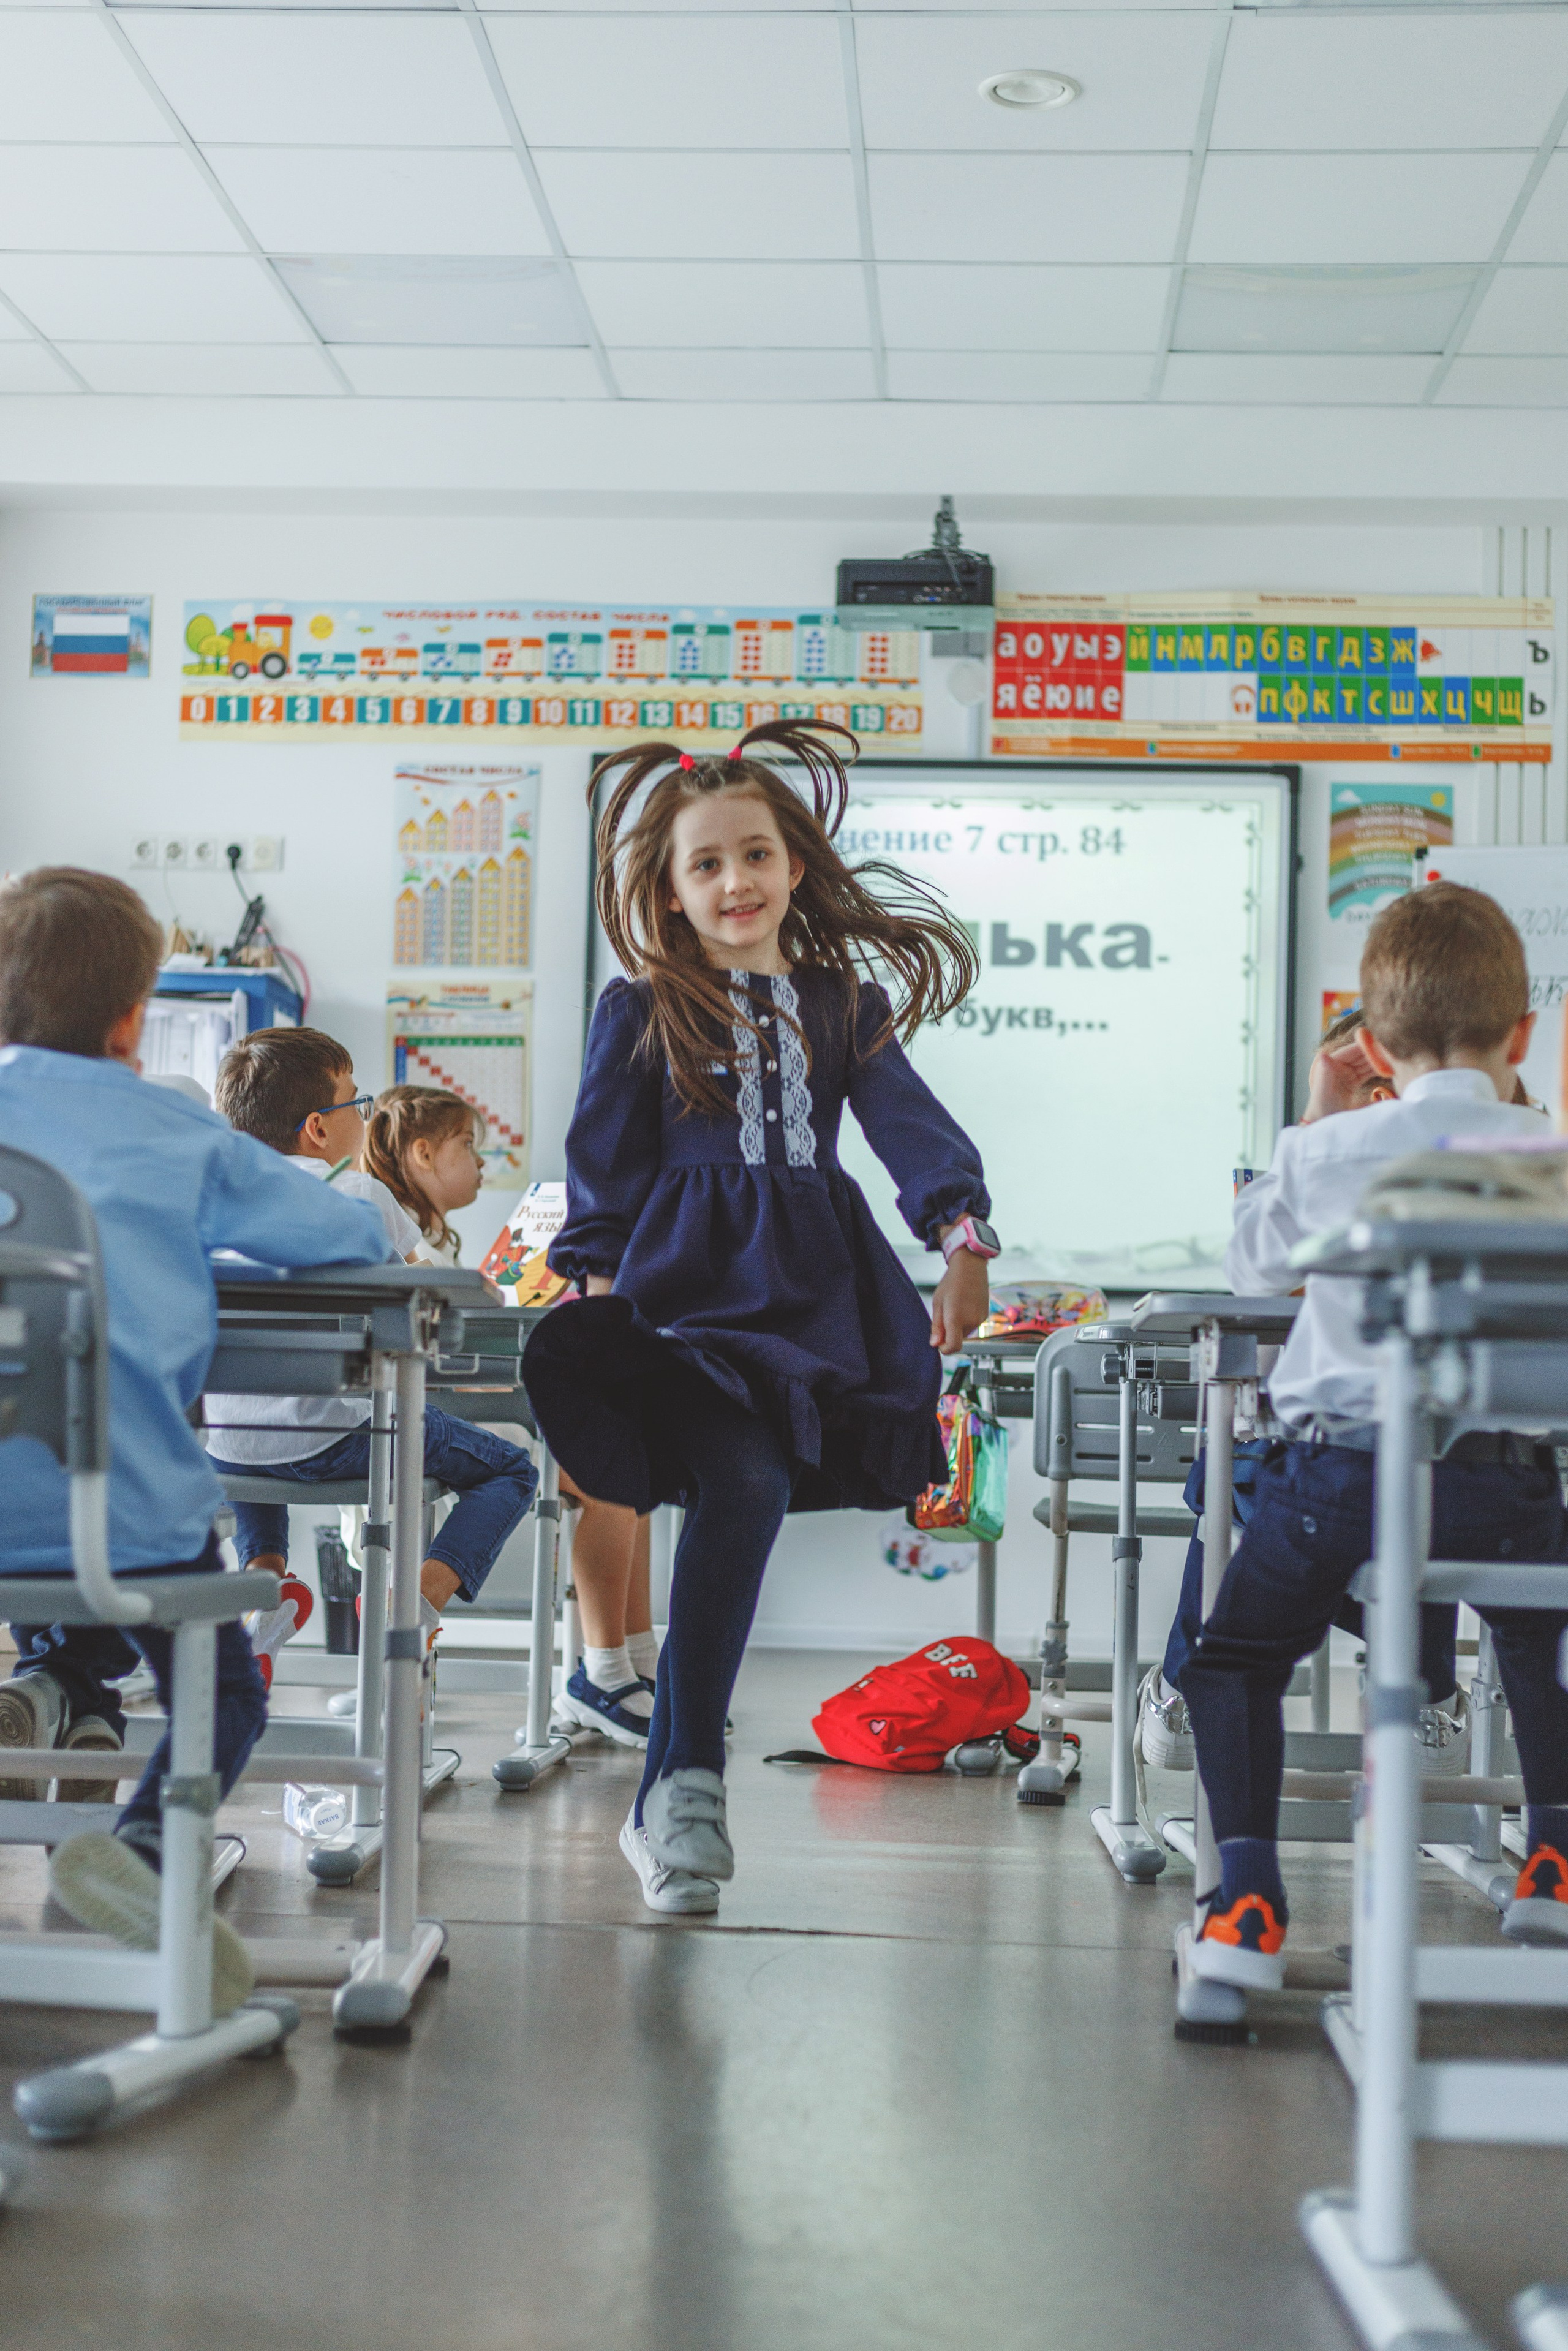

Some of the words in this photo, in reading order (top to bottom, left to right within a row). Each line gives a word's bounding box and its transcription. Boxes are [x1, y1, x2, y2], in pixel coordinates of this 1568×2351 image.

[383, 608, 477, 621] ЧИСЛОВОЙ
[533, 610, 601, 621] СОСТАВ
[612, 611, 669, 623] ЧИСЛА
[190, 697, 206, 720] 0
[226, 698, 238, 721] 1
[259, 697, 276, 720] 2
[295, 697, 311, 720] 3
[330, 697, 346, 721] 4
[366, 698, 382, 722] 5
[401, 698, 417, 721] 6
[436, 699, 452, 722] 7
[471, 700, 488, 723] 8
[507, 700, 522, 723] 9
[538, 700, 563, 724] 10
[573, 701, 595, 724] 11
[610, 702, 633, 725] 12
[646, 703, 669, 725] 13
[680, 703, 704, 726] 14
[715, 704, 739, 728] 15
[751, 704, 774, 727] 16
[821, 706, 845, 729] 18
[859, 707, 881, 730] 19
[891, 708, 918, 731] 20
[838, 828, 952, 853] нение
[966, 825, 985, 853] 7
[998, 831, 1069, 862] стр.
[1080, 826, 1126, 855] 84
[965, 921, 1170, 970] ька-
[517, 1205, 564, 1221] Русский
[533, 1221, 563, 1232] язы
[924, 1643, 978, 1680] BFF
